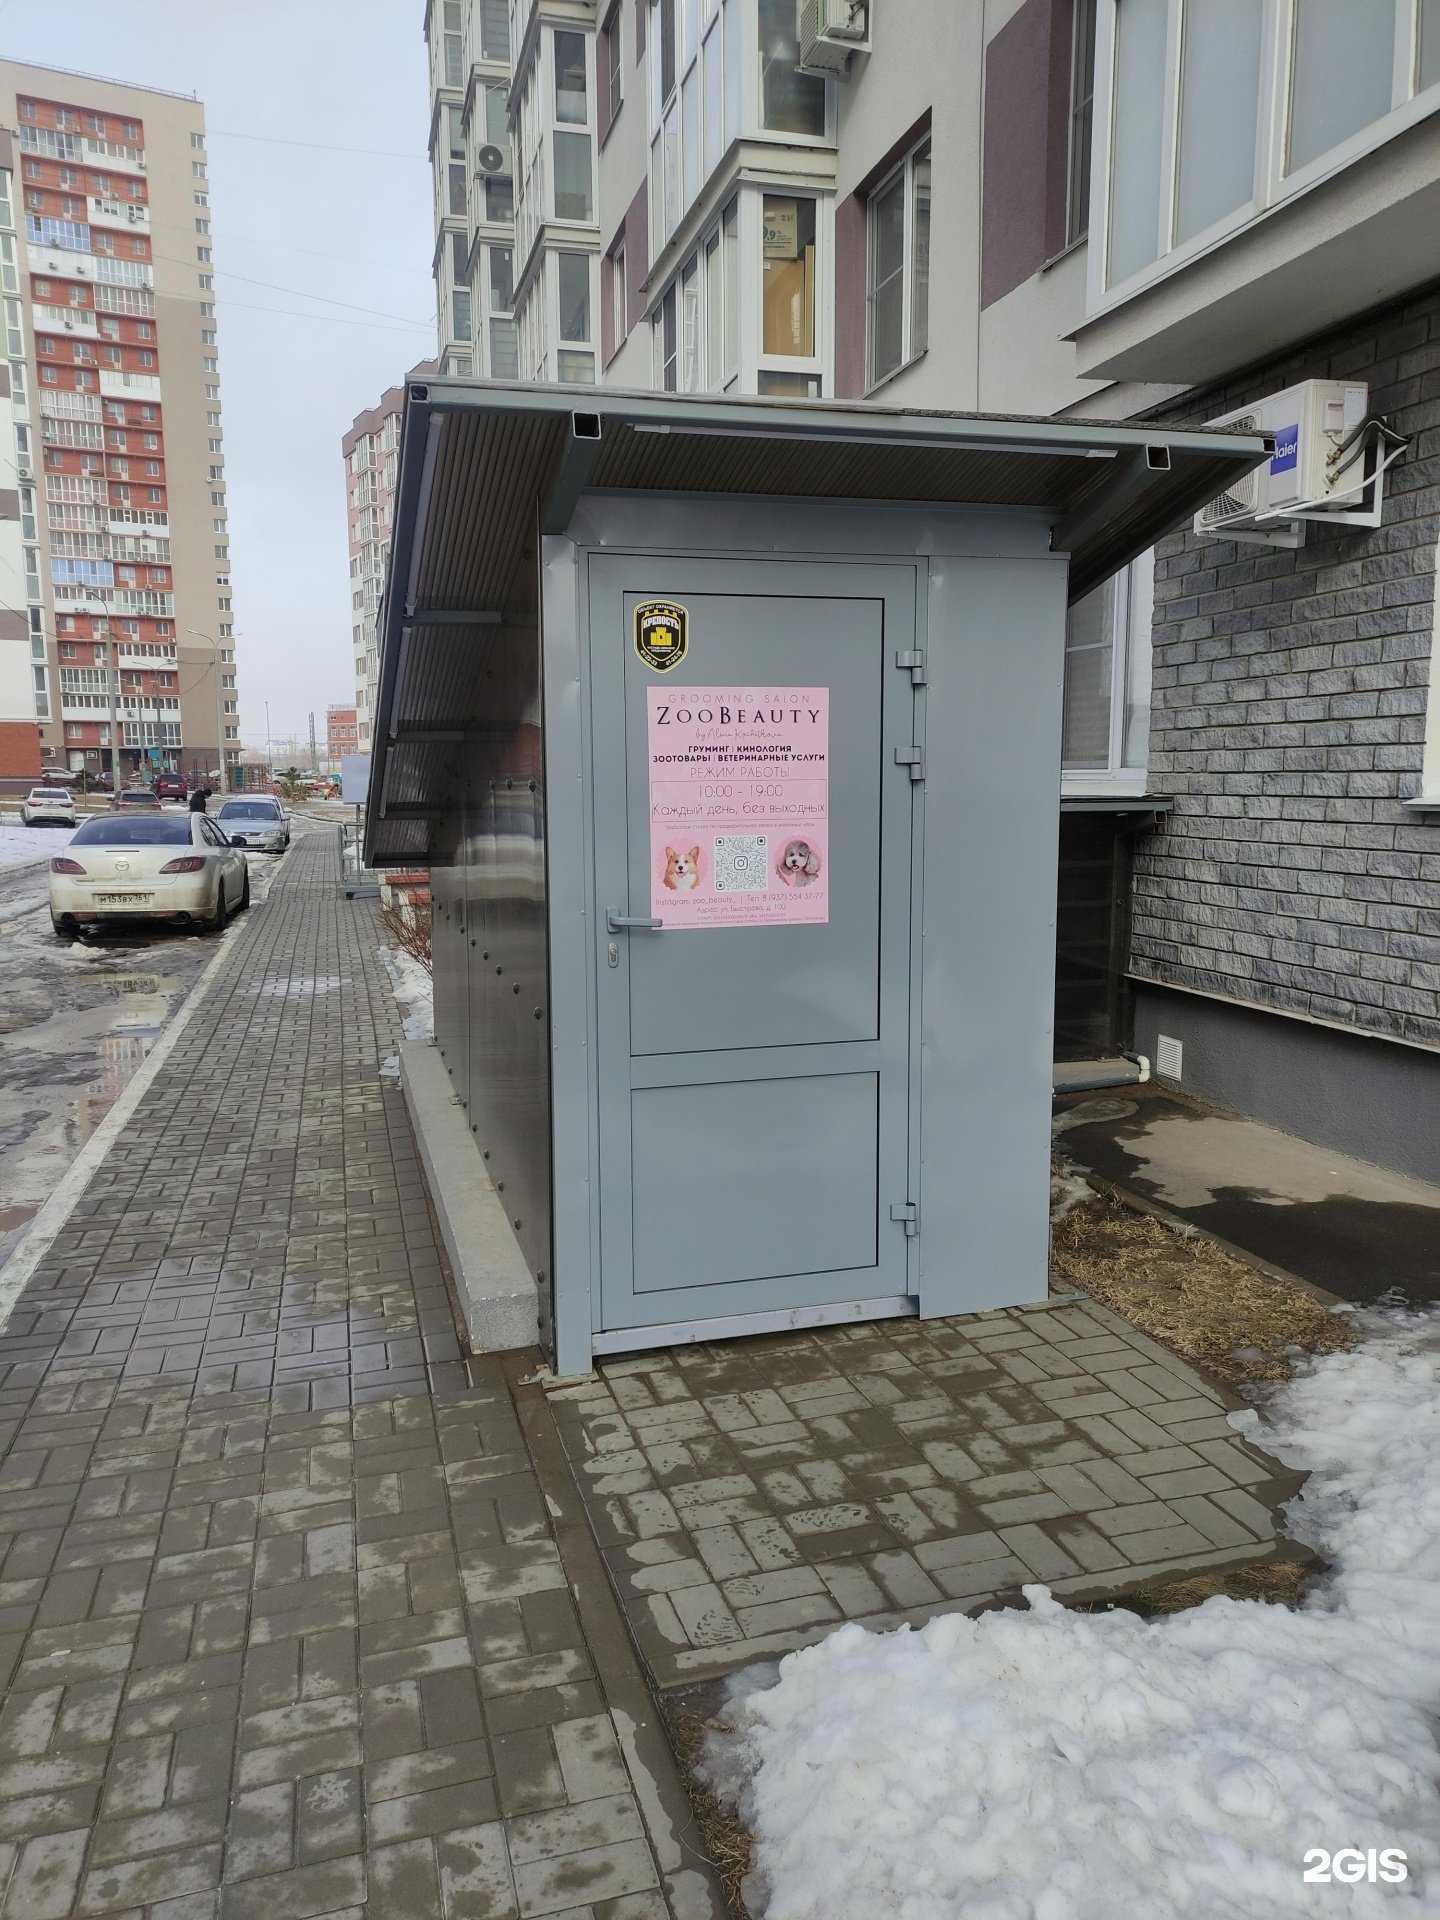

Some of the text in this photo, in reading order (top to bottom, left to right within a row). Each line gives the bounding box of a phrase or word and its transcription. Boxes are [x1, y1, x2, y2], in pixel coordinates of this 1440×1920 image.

[643, 615, 679, 629] КРЕПОСТЬ
[668, 694, 809, 704] GROOMING SALON
[688, 745, 730, 753] ГРУМИНГ
[653, 754, 711, 762] ЗООТОВАРЫ
[690, 767, 790, 778] РЕЖИМ РАБОТЫ
[653, 801, 825, 817] Каждый день, без выходных
